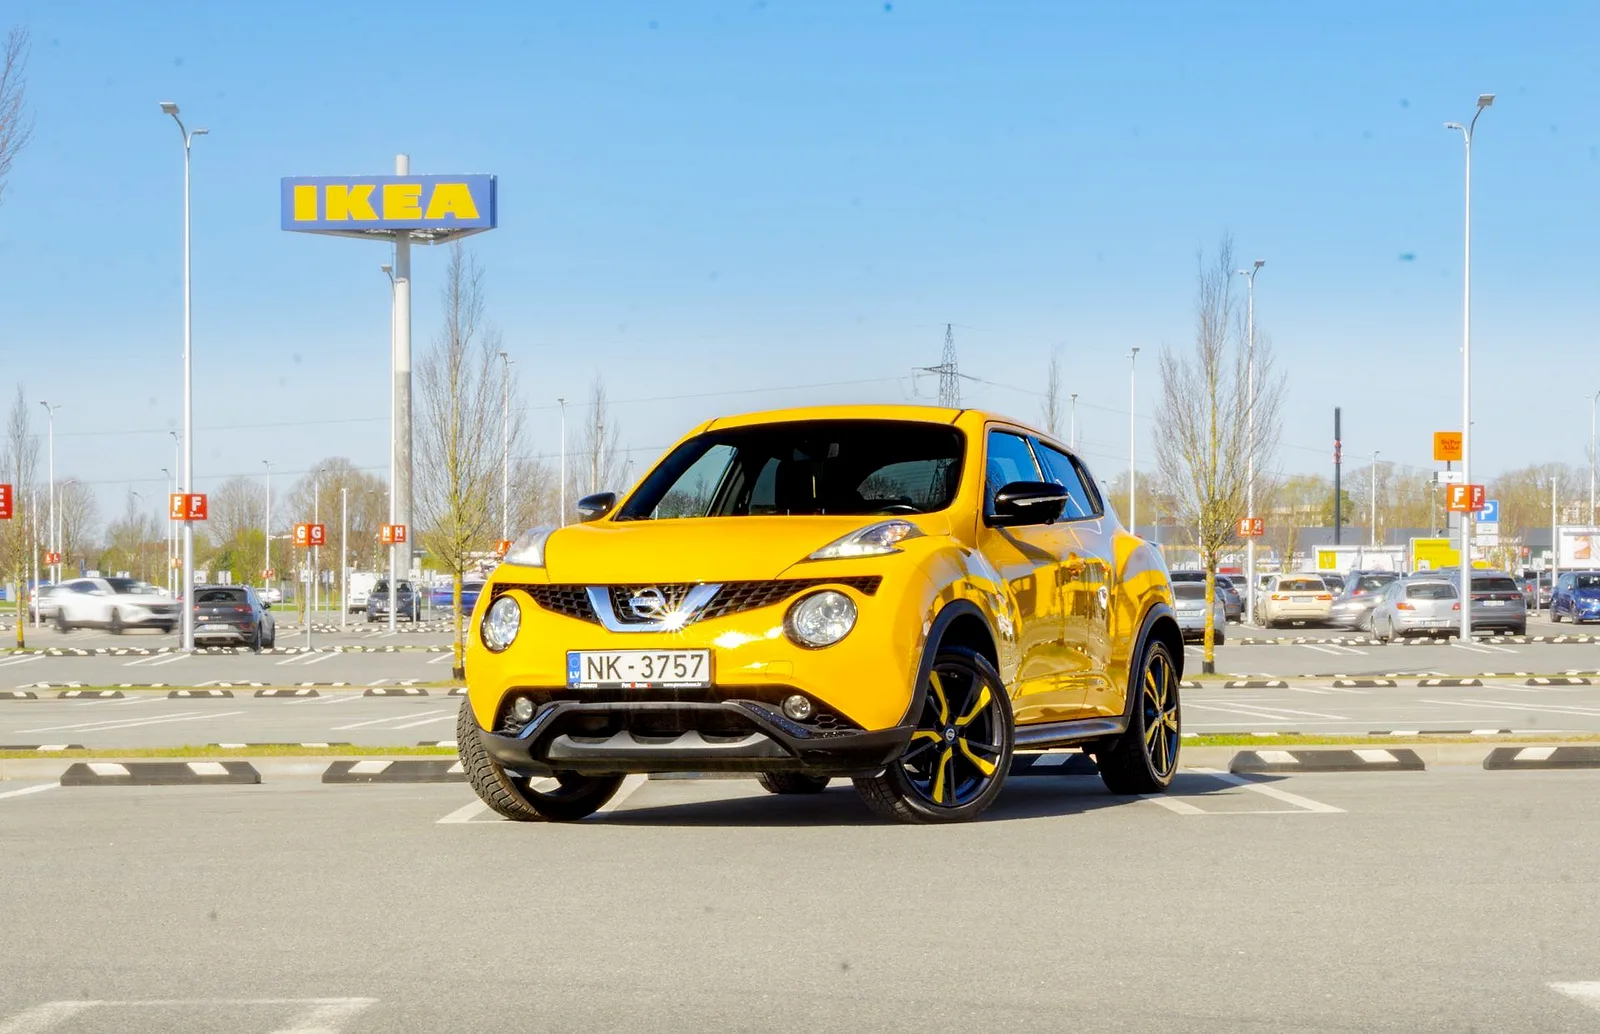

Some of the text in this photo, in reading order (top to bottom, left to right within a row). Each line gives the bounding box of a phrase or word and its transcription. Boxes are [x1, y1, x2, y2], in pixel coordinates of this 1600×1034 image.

[294, 183, 480, 221] IKEA
[1454, 487, 1464, 502] F
[1474, 487, 1481, 502] F
[174, 496, 182, 511] F
[192, 496, 202, 511] F
[382, 526, 390, 537] H
[395, 526, 403, 537] H
[1241, 519, 1250, 530] H
[297, 526, 306, 539] G
[311, 526, 322, 539] G
[588, 654, 704, 679] NK-3757
